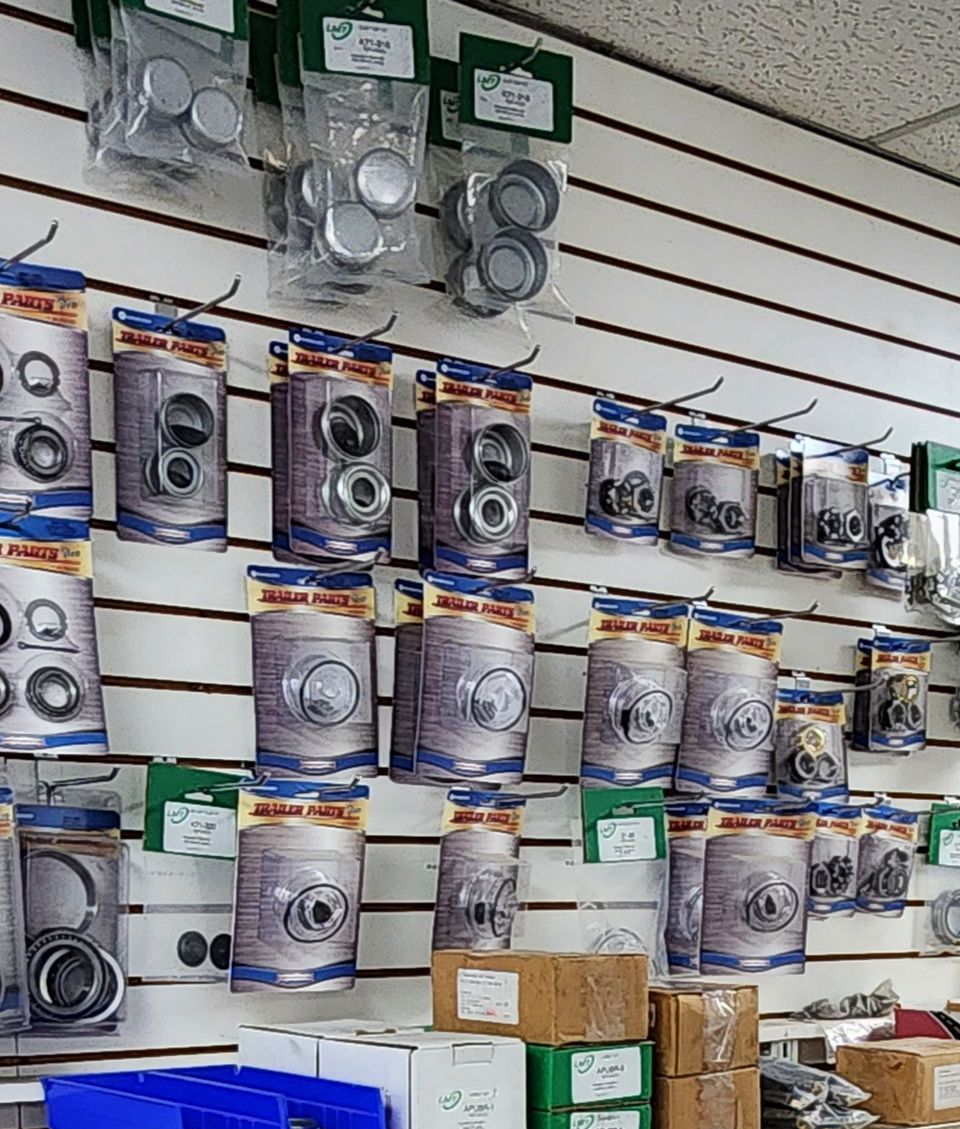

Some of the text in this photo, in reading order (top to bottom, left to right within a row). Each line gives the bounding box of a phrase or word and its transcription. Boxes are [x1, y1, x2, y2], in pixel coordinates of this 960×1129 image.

[1, 291, 55, 315] PARTS
[115, 329, 169, 351] TRAILER
[170, 340, 209, 358] PARTS
[291, 351, 339, 371] TRAILER
[340, 361, 377, 378] PARTS
[438, 380, 482, 399] TRAILER
[482, 388, 517, 404] PARTS
[6, 543, 59, 562] PARTS
[257, 589, 310, 605] TRAILER
[311, 592, 351, 606] PARTS
[432, 594, 479, 614] TRAILER
[480, 602, 516, 619] PARTS
[596, 618, 640, 634] TRAILER
[640, 621, 670, 635] PARTS
[695, 629, 734, 646] TRAILER
[735, 635, 765, 649] PARTS
[249, 801, 304, 818] TRAILER
[305, 804, 345, 819] PARTS
[715, 816, 761, 831] TRAILER
[762, 817, 799, 830] PARTS
